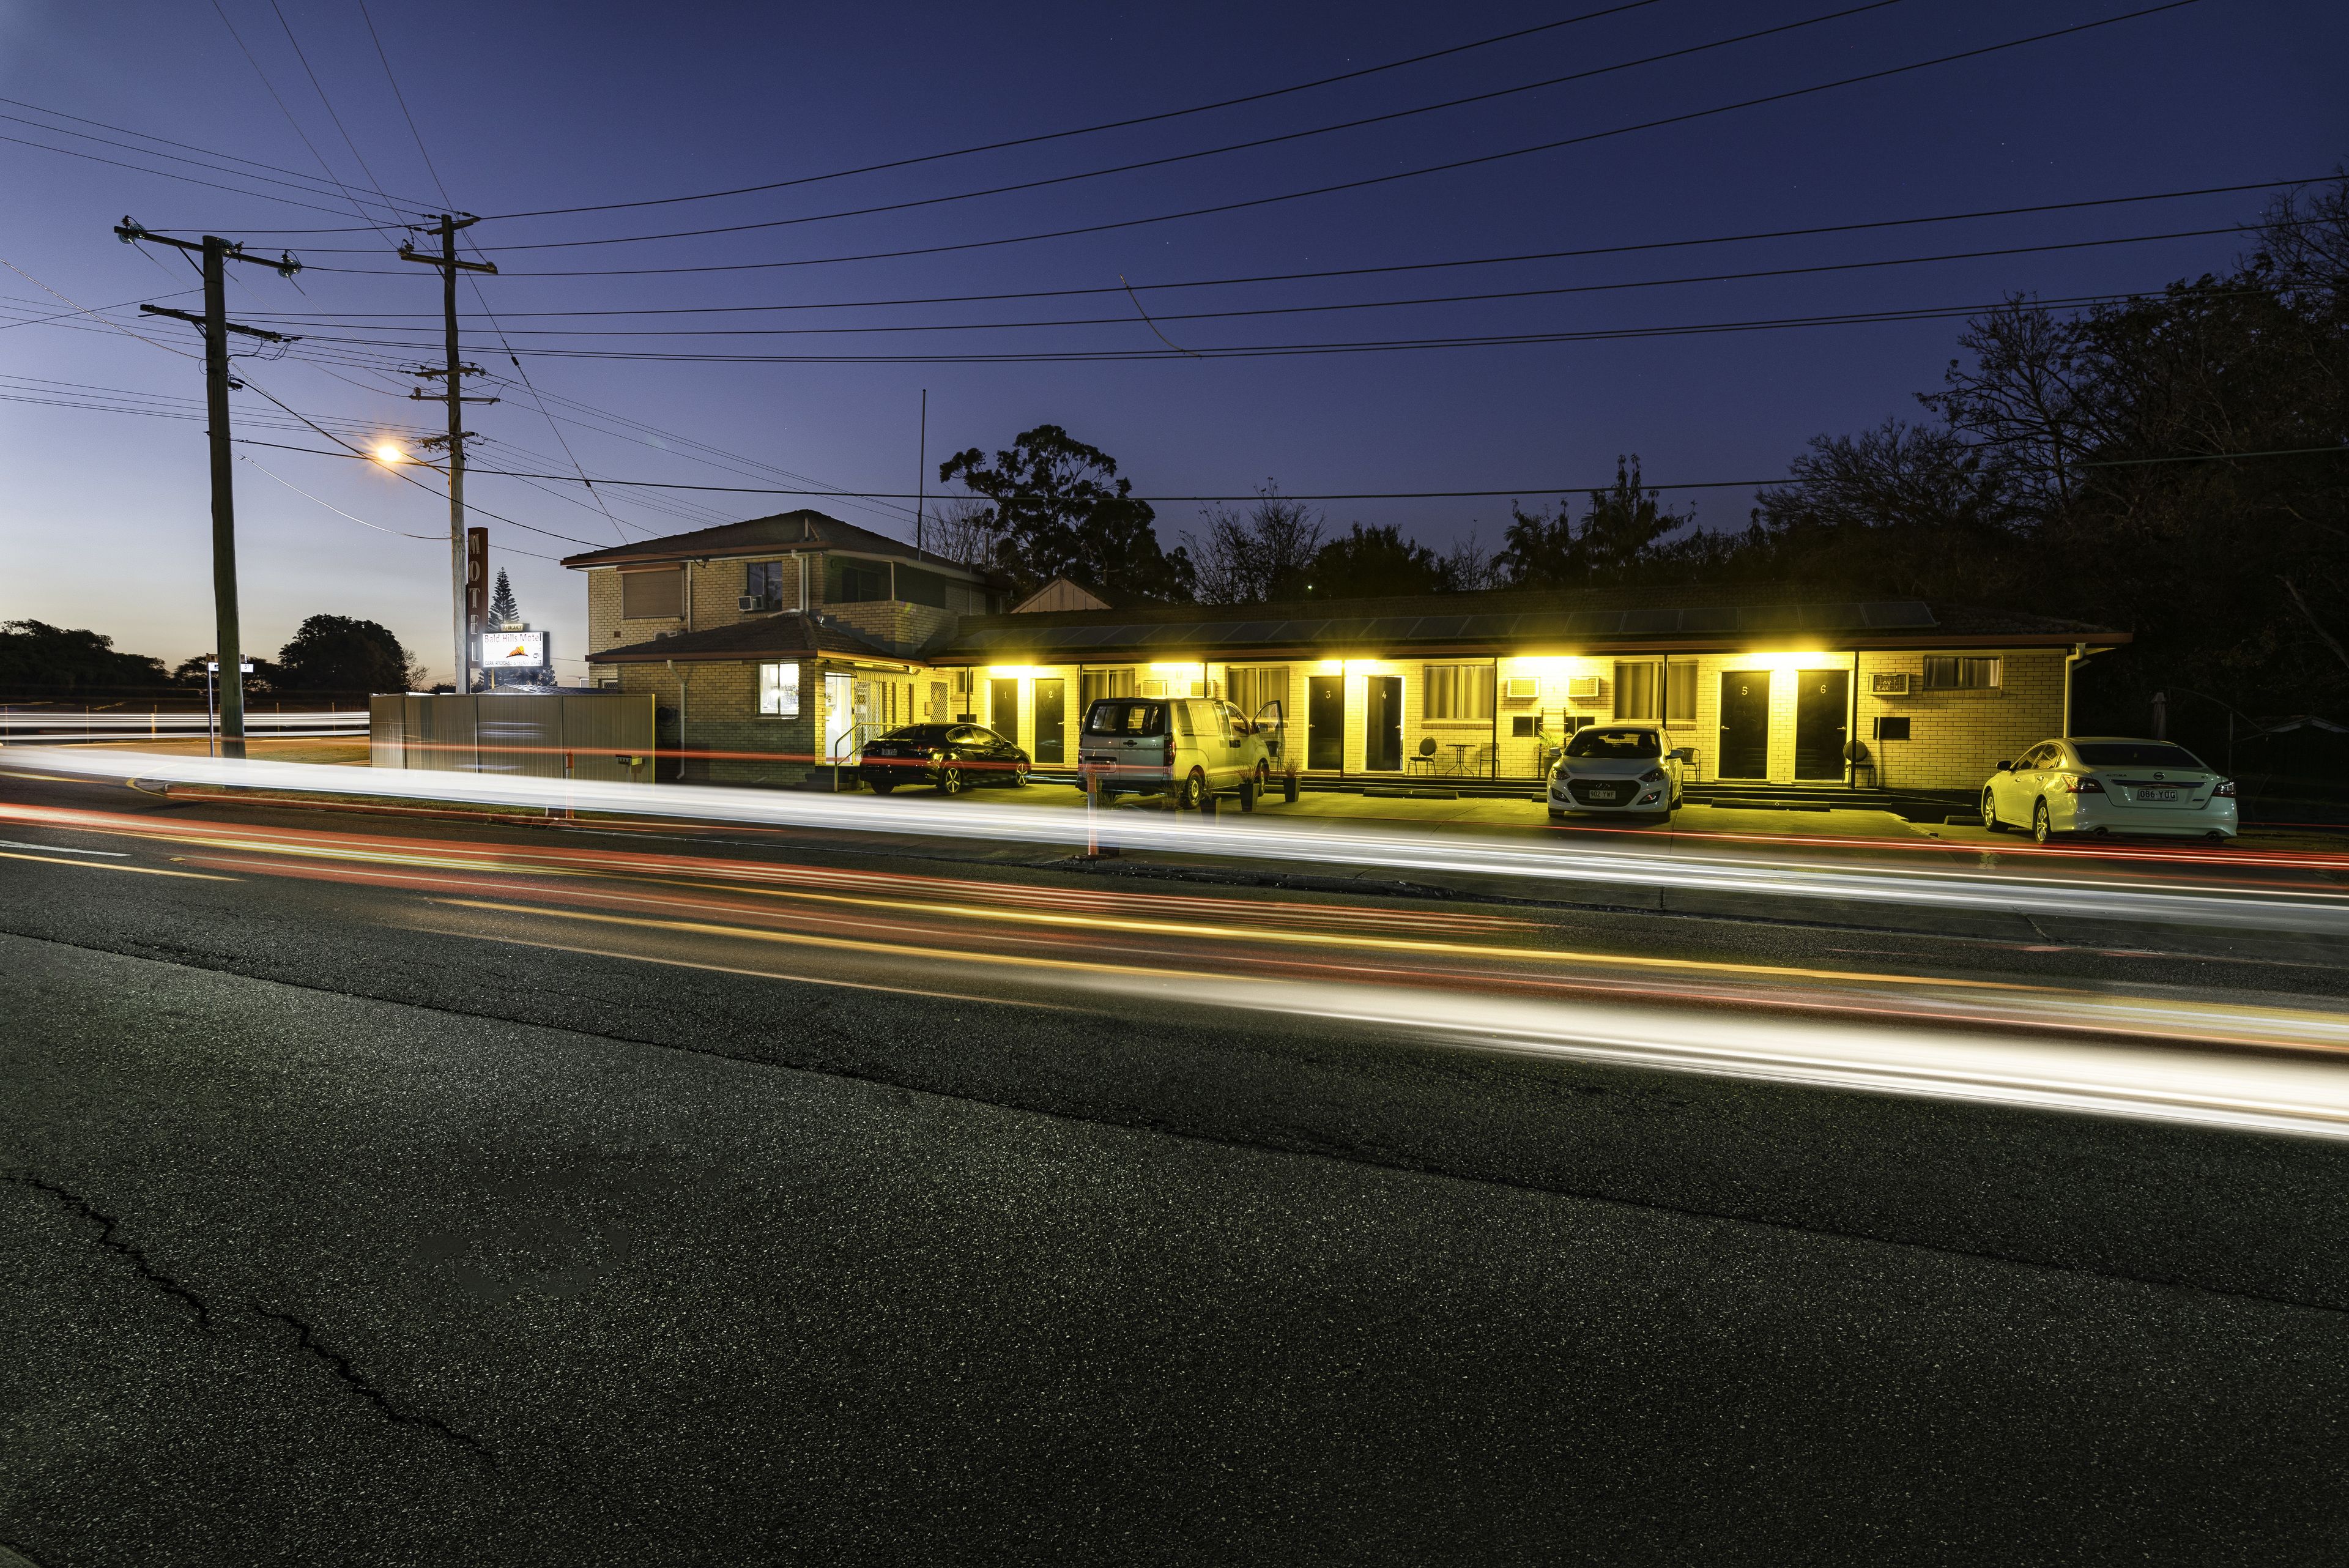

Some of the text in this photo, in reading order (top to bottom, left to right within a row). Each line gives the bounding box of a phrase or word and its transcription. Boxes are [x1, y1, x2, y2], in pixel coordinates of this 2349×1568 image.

[467, 534, 480, 661] MOTEL
[502, 634, 518, 642] Hills
[520, 633, 541, 642] Motel
[1742, 686, 1748, 695] 5
[1820, 685, 1827, 694] 6
